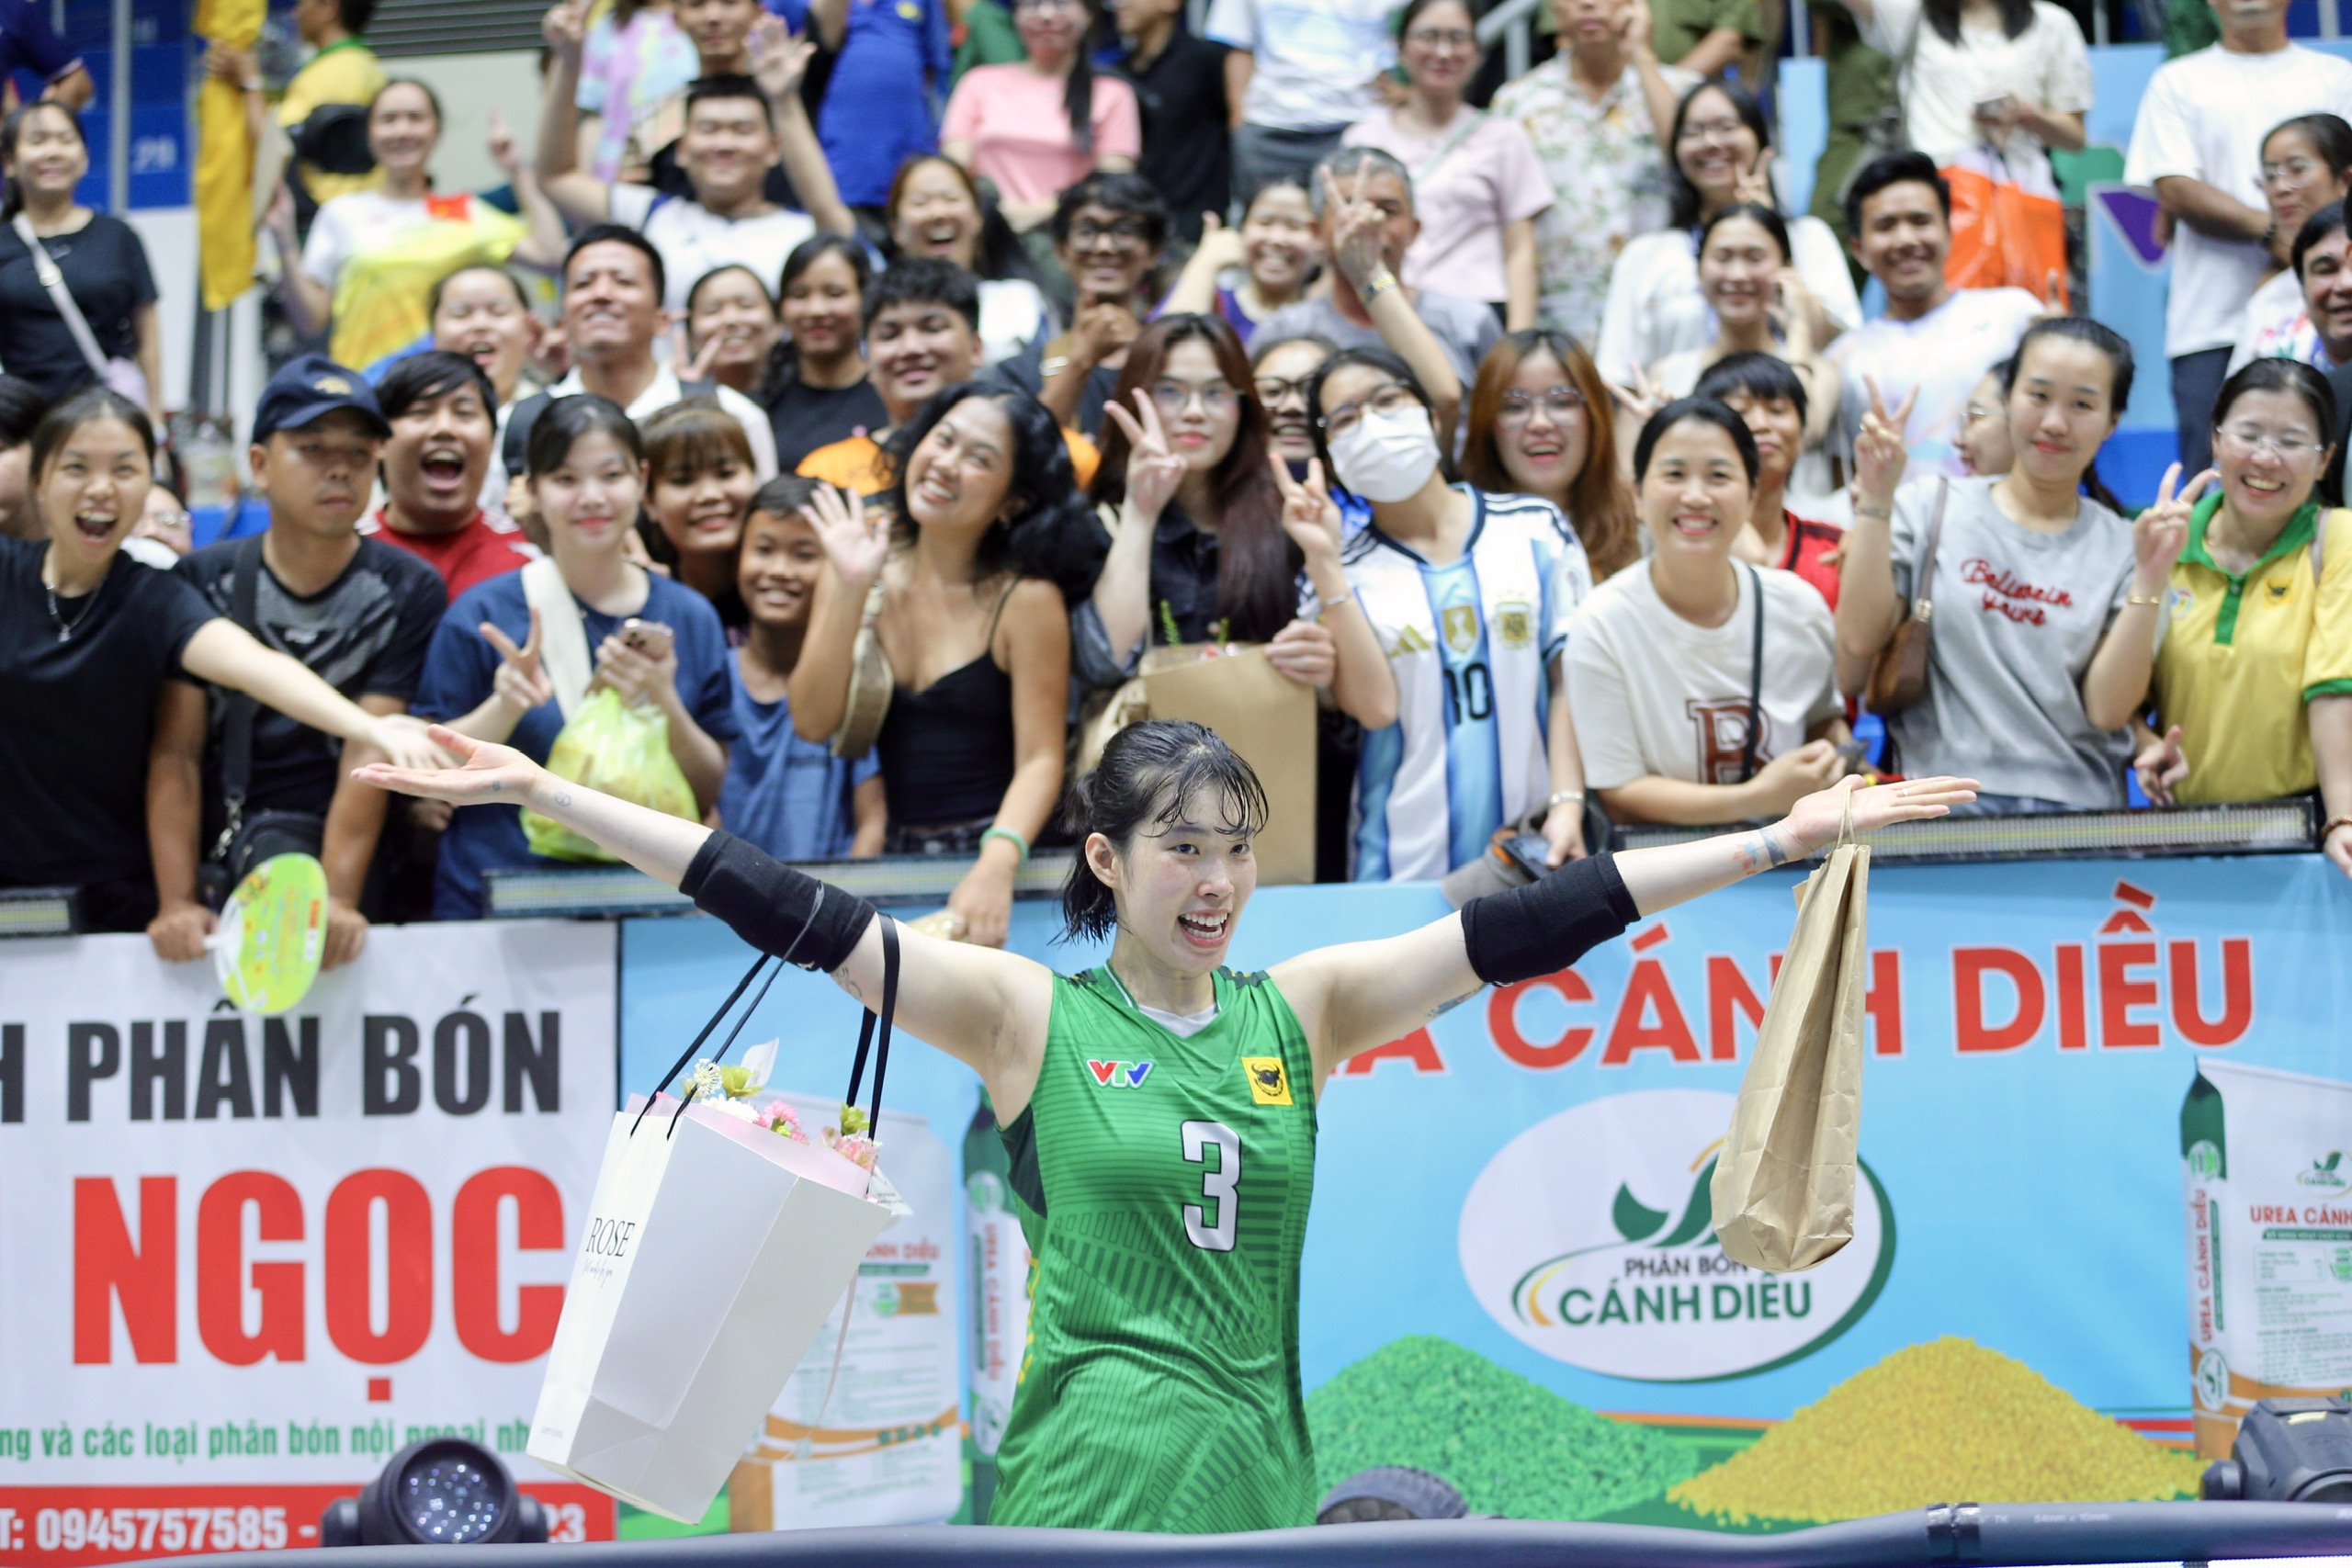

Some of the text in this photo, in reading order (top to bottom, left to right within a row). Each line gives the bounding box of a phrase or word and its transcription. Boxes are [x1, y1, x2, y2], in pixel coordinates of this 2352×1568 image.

[1442, 661, 1492, 726] 10
[1953, 880, 2252, 1054] DIỀU
[67, 998, 320, 1122] PHÂN
[364, 994, 561, 1117] BÓN
[1088, 1059, 1153, 1088] VTV
[1181, 1119, 1241, 1252] 3
[585, 1217, 636, 1258] ROSE
[2250, 1205, 2297, 1224] UREA
[74, 1166, 565, 1401] NGỌC
[1625, 1252, 1690, 1277] PHÂN
[1559, 1278, 1701, 1325] CÁNH
[41, 1421, 73, 1457] và
[84, 1421, 134, 1457] các
[145, 1421, 198, 1465] loại
[209, 1419, 278, 1459] phân
[288, 1421, 340, 1455] bón
[351, 1420, 394, 1462] nội
[37, 1506, 288, 1551] 0945757585
